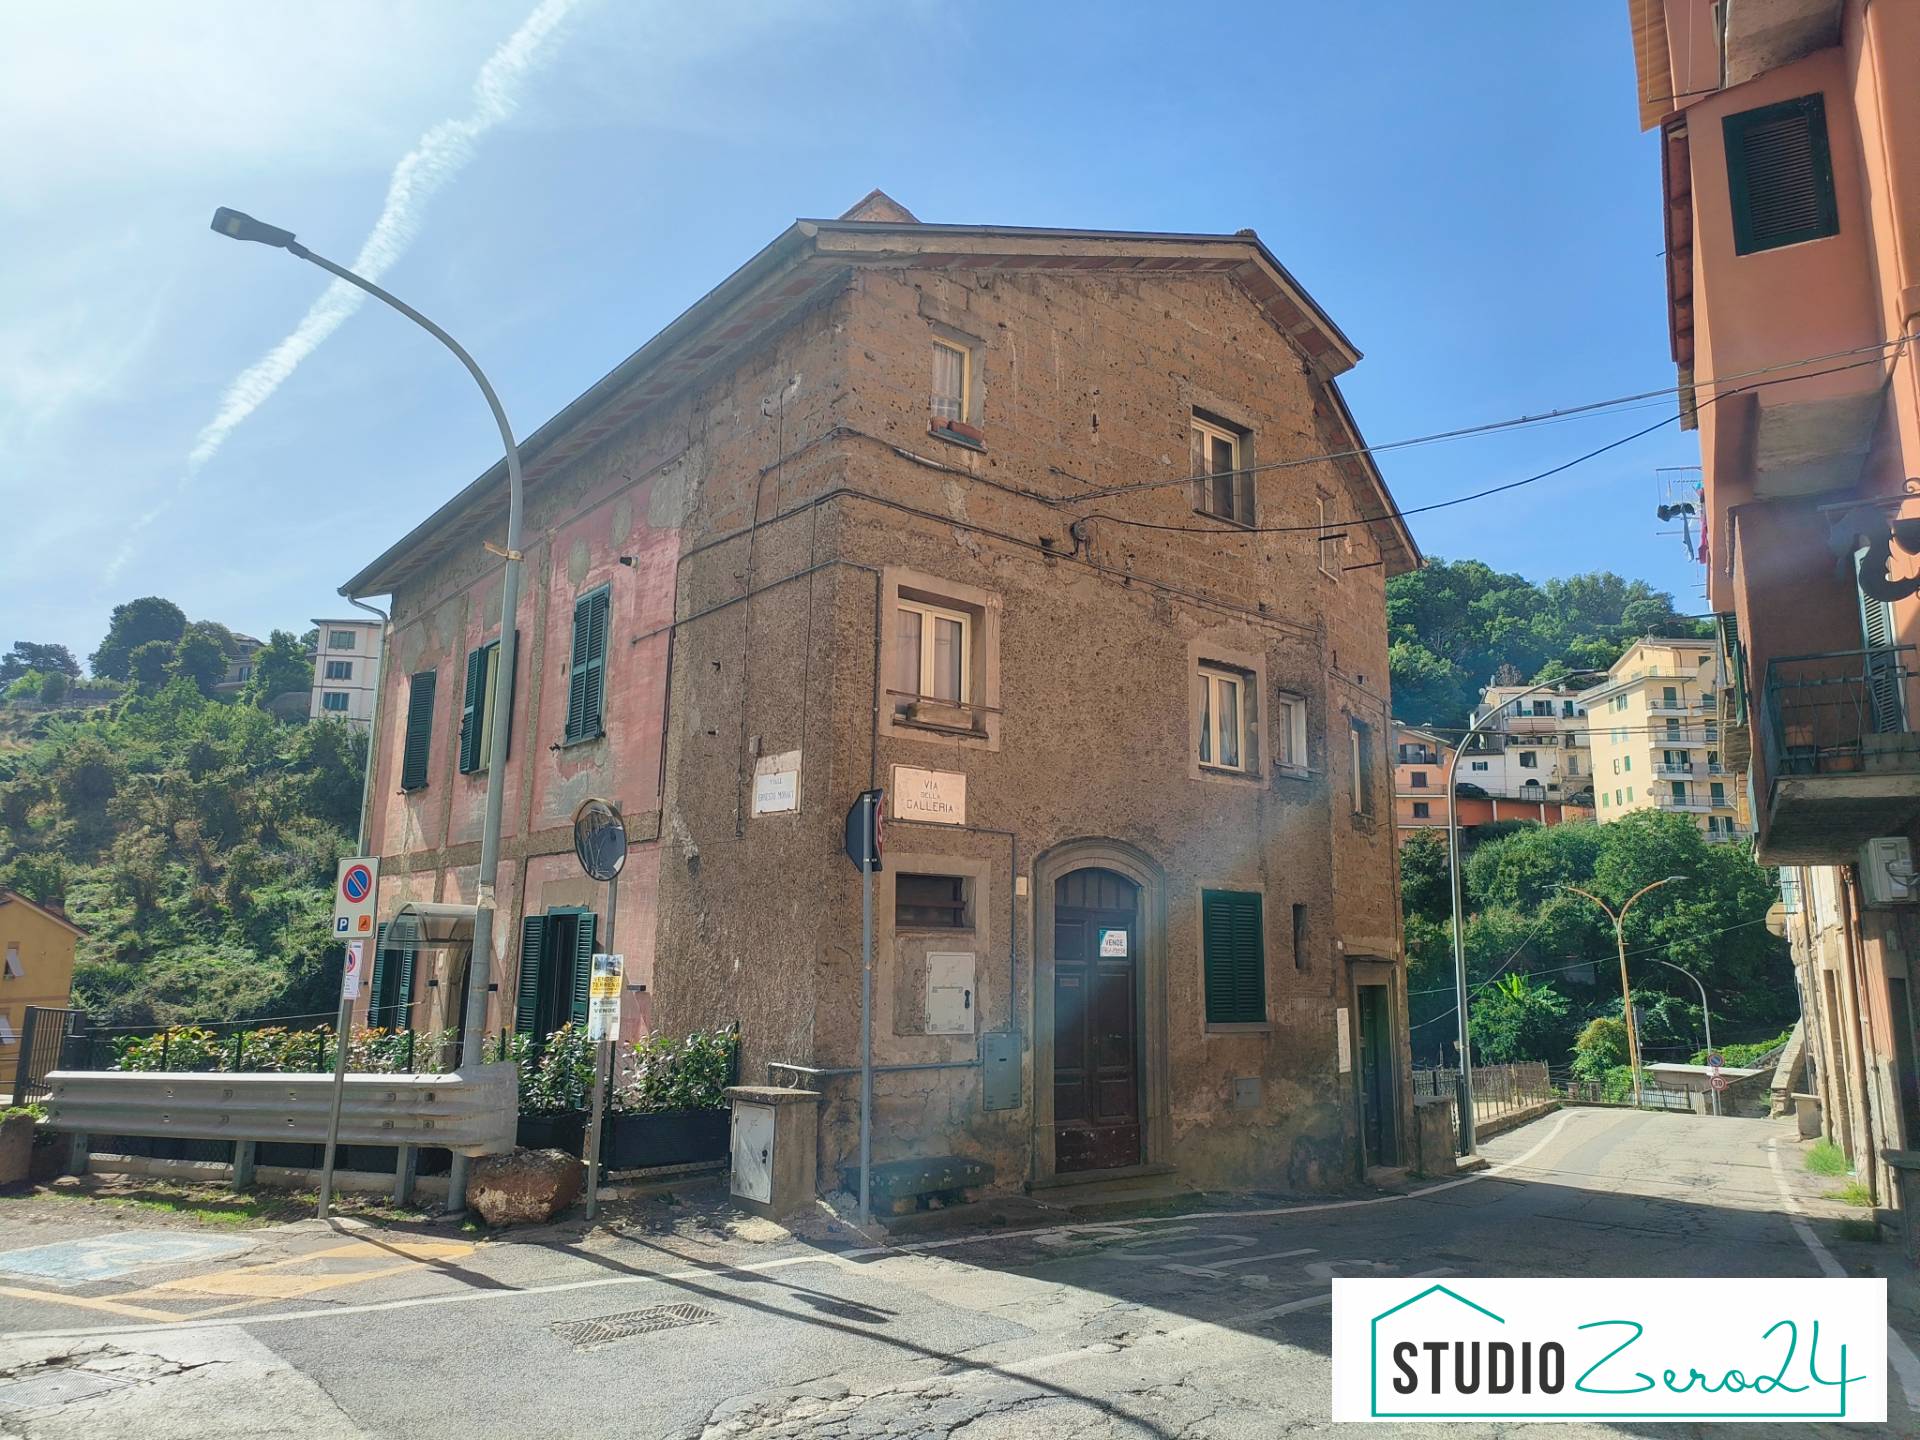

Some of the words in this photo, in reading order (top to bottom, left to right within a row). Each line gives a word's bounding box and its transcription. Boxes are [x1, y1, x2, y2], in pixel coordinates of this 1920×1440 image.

[924, 779, 938, 790] VIA
[906, 799, 953, 813] GALLERIA
[339, 918, 348, 930] P
[1105, 938, 1124, 946] VENDE
